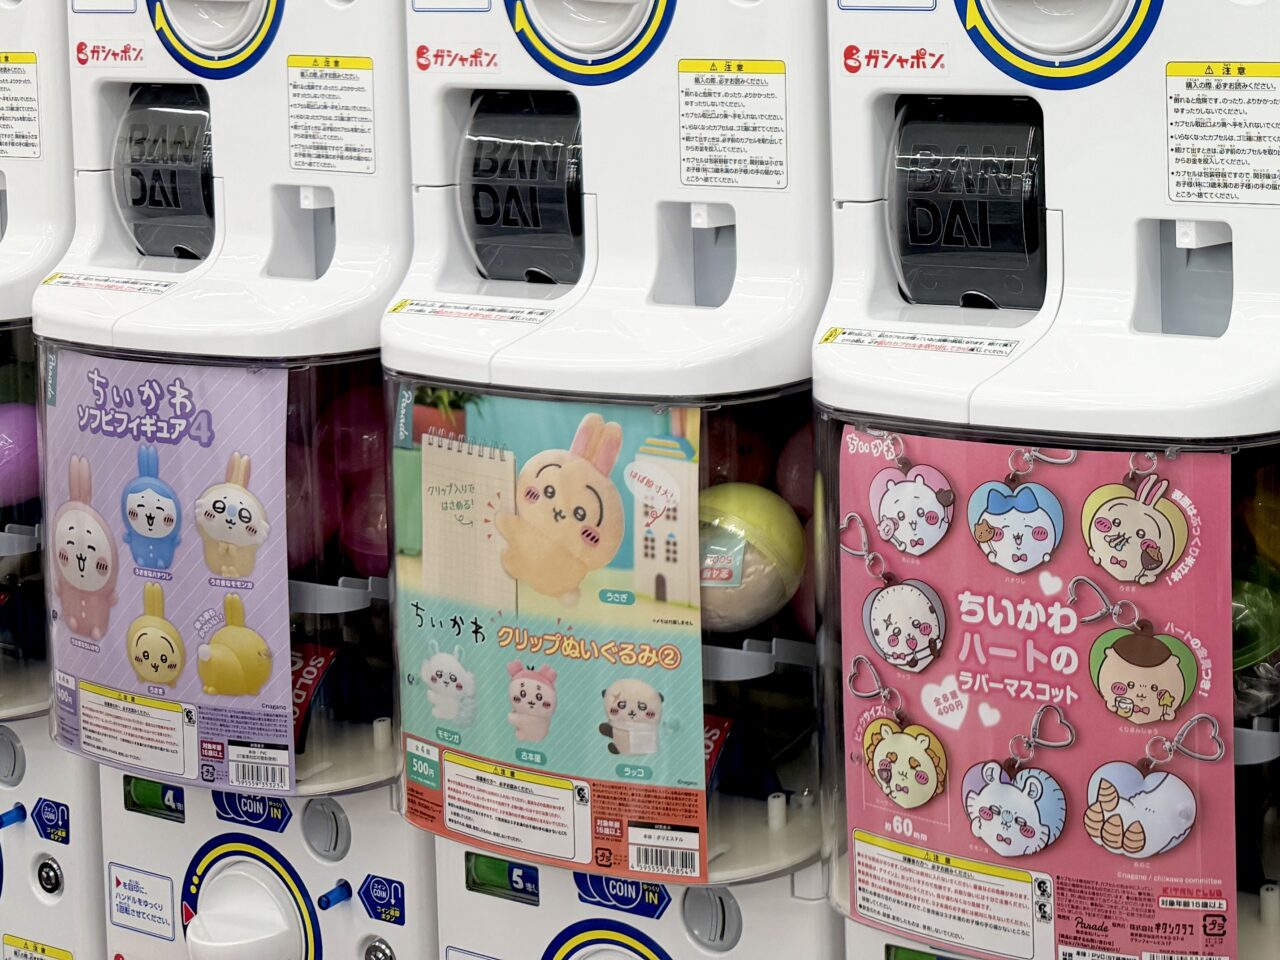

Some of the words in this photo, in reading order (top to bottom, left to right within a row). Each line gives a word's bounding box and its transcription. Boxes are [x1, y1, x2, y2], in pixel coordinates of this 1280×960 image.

[433, 47, 498, 67] ガシャポン
[864, 46, 944, 69] ガシャポン
[1222, 67, 1245, 75] 注意
[128, 168, 181, 209] DAI
[473, 184, 542, 229] DAI
[908, 198, 991, 248] DAI
[88, 369, 196, 415] ちいかわ
[78, 405, 214, 446] ソフビフィギュア4
[209, 578, 253, 589] うさぎなモモンガ
[606, 592, 628, 602] うさぎ
[411, 601, 485, 643] ちいかわ
[957, 591, 1078, 635] ちいかわ
[497, 626, 682, 669] クリップぬいぐるみ②
[957, 633, 1078, 675] ハートの
[957, 672, 1078, 705] ラバーマスコット
[938, 700, 963, 716] 400円
[438, 731, 460, 743] モモンガ
[412, 758, 435, 778] 500円
[624, 767, 644, 777] ラッコ
[164, 790, 175, 810] 4
[240, 797, 264, 815] COIN
[270, 806, 282, 820] IN
[512, 869, 524, 890] 5
[609, 882, 637, 900] COIN
[644, 891, 659, 905] IN
[115, 893, 163, 911] ハンドルをゆっくり
